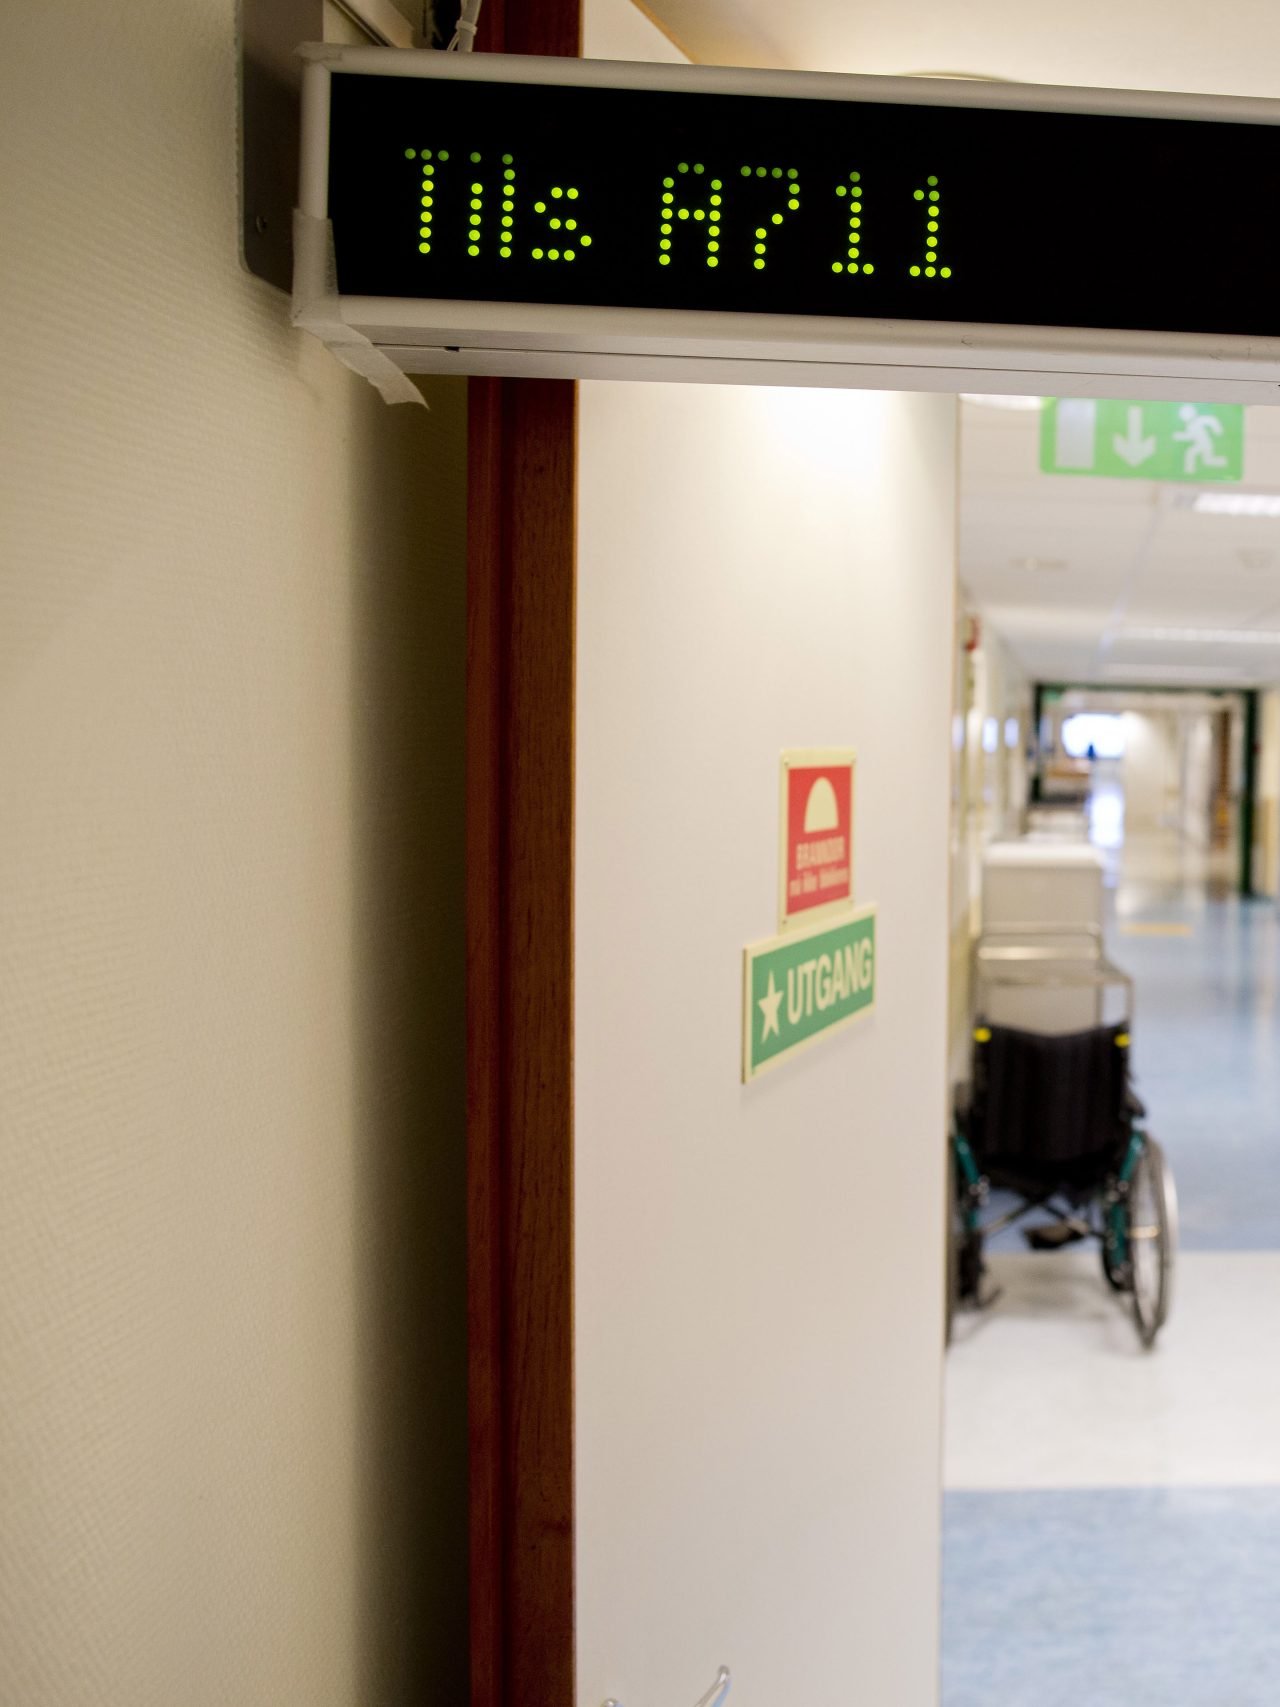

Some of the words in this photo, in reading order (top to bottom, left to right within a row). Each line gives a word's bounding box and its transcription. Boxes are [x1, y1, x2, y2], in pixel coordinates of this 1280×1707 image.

[404, 147, 592, 262] Tils
[658, 162, 952, 279] A711
[787, 938, 872, 1024] UTGANG
